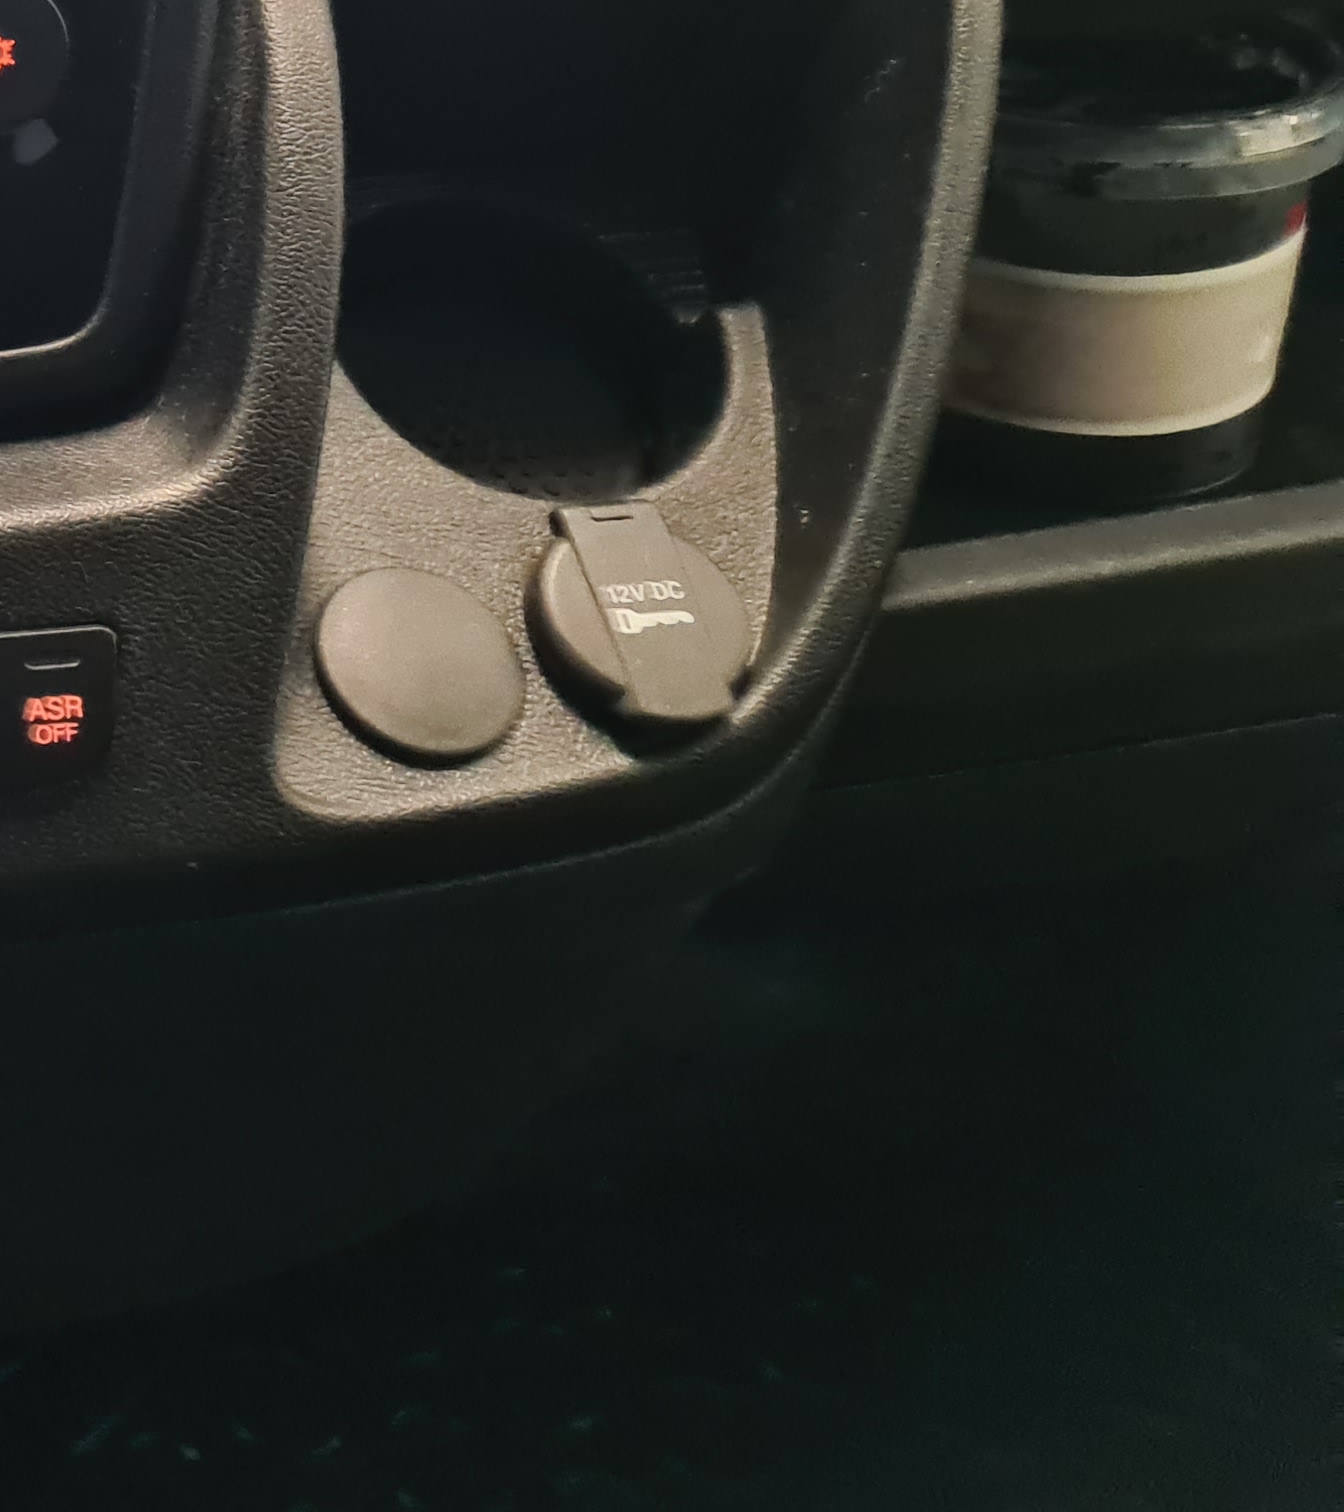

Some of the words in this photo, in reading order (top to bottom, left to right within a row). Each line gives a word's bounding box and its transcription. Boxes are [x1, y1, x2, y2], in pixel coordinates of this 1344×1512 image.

[602, 583, 645, 604] 12V
[644, 579, 686, 601] DC
[22, 694, 84, 722] ASR
[28, 722, 79, 745] OFF
